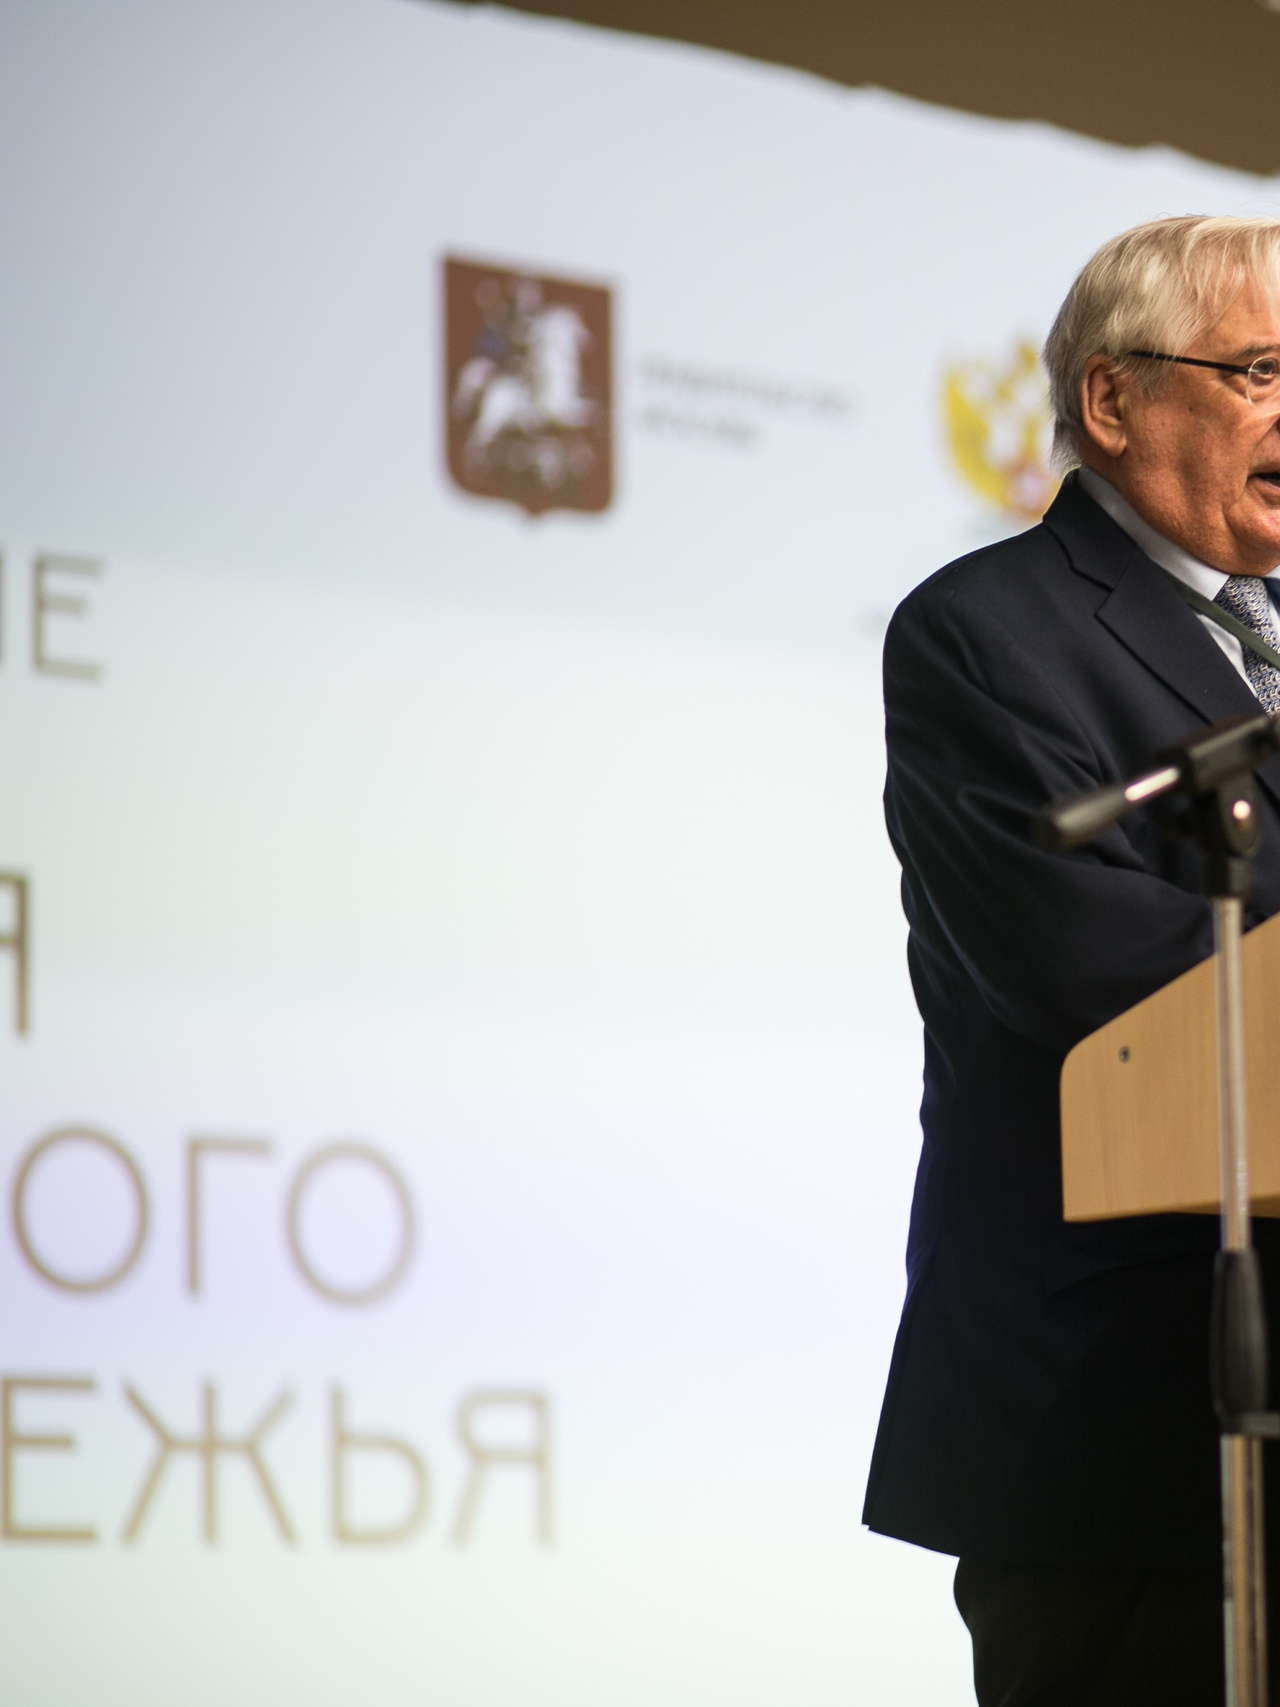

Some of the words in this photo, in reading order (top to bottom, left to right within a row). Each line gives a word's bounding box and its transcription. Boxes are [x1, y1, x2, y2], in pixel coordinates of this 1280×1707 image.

[0, 542, 106, 686] Е
[8, 1120, 420, 1312] ОГО
[0, 1374, 558, 1552] ЕЖЬЯ
